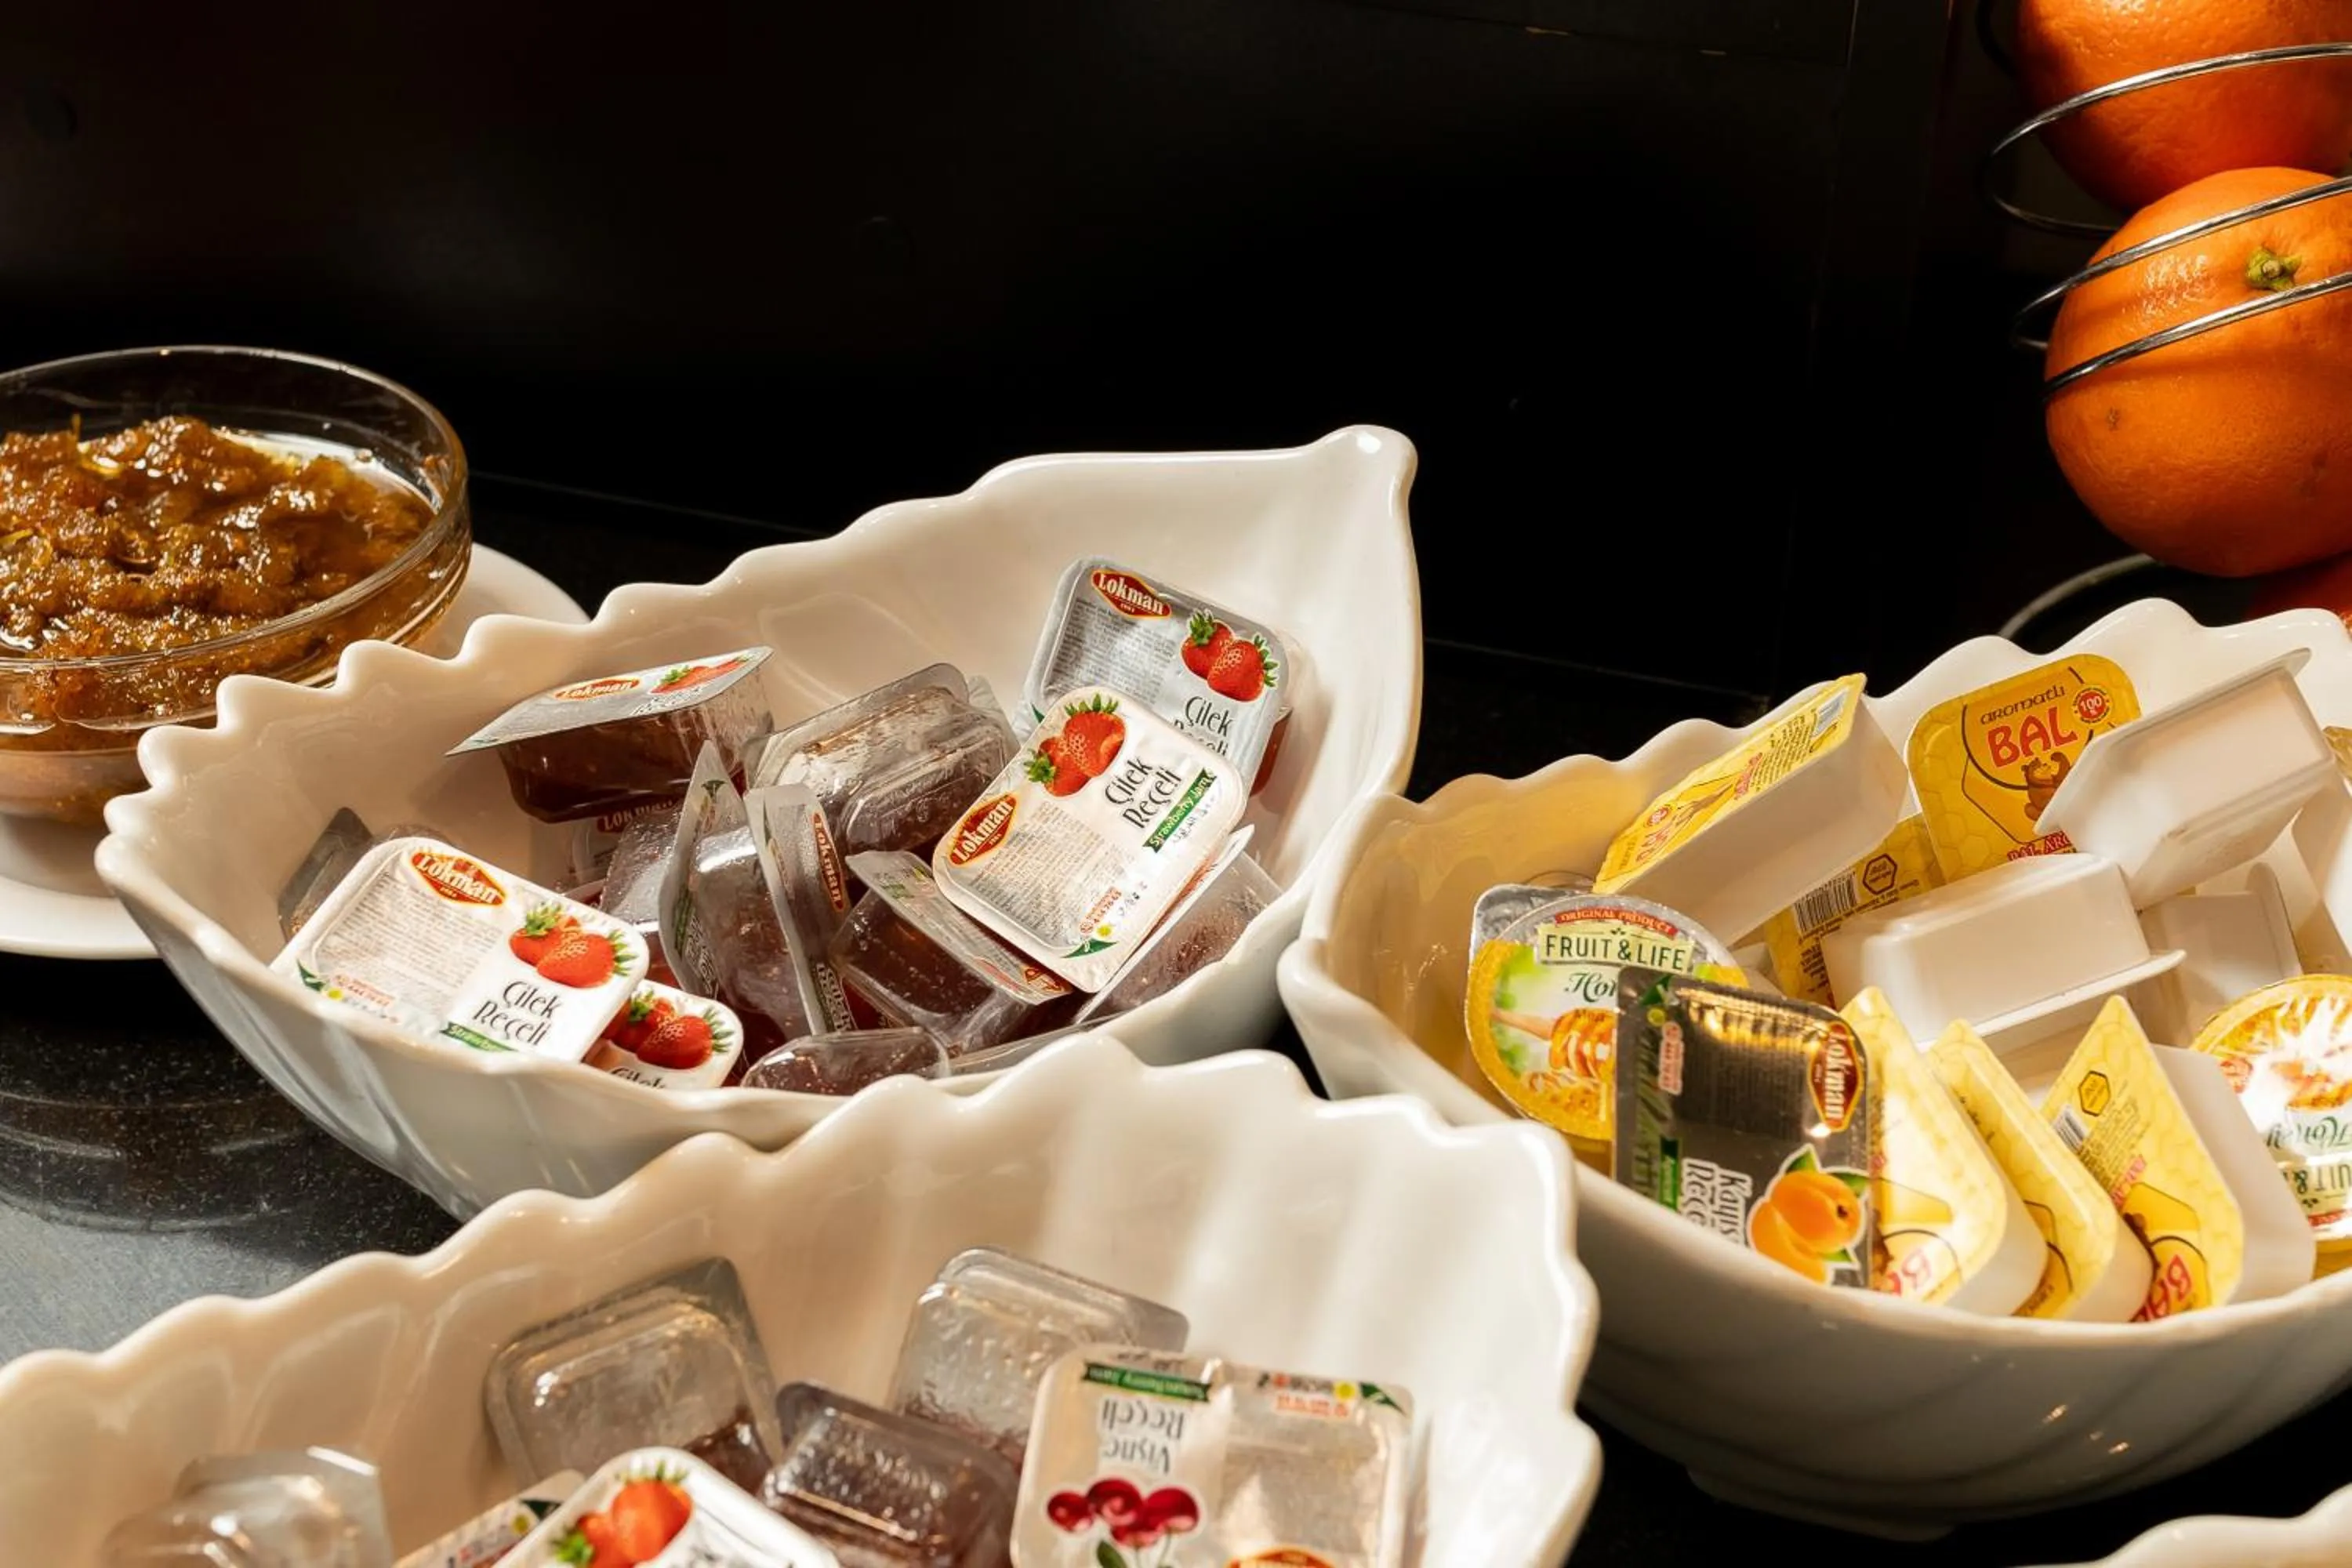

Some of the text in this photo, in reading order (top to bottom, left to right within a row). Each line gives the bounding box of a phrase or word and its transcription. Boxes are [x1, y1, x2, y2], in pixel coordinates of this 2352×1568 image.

[1098, 573, 1166, 616] Lokman
[563, 681, 636, 699] Lokman
[2081, 696, 2103, 711] 100
[1185, 696, 1233, 738] Çilek
[1987, 706, 2078, 768] BAL
[1105, 755, 1153, 806] Çilek
[1123, 766, 1181, 829] Reçeli
[952, 800, 1014, 862] Lokman
[1149, 792, 1196, 847] Strawberry
[417, 854, 496, 904] Lokman
[815, 819, 843, 903] Lokman
[1560, 909, 1672, 933] ORIGINAL PRODUCT
[1546, 935, 1687, 971] FRUIT & LIFE
[503, 980, 563, 1019] Çilek
[473, 1000, 551, 1046] Reçeli
[1824, 1033, 1849, 1120] Lokman
[1102, 1398, 1186, 1440] Reçeli
[1102, 1438, 1171, 1475] Vişne
